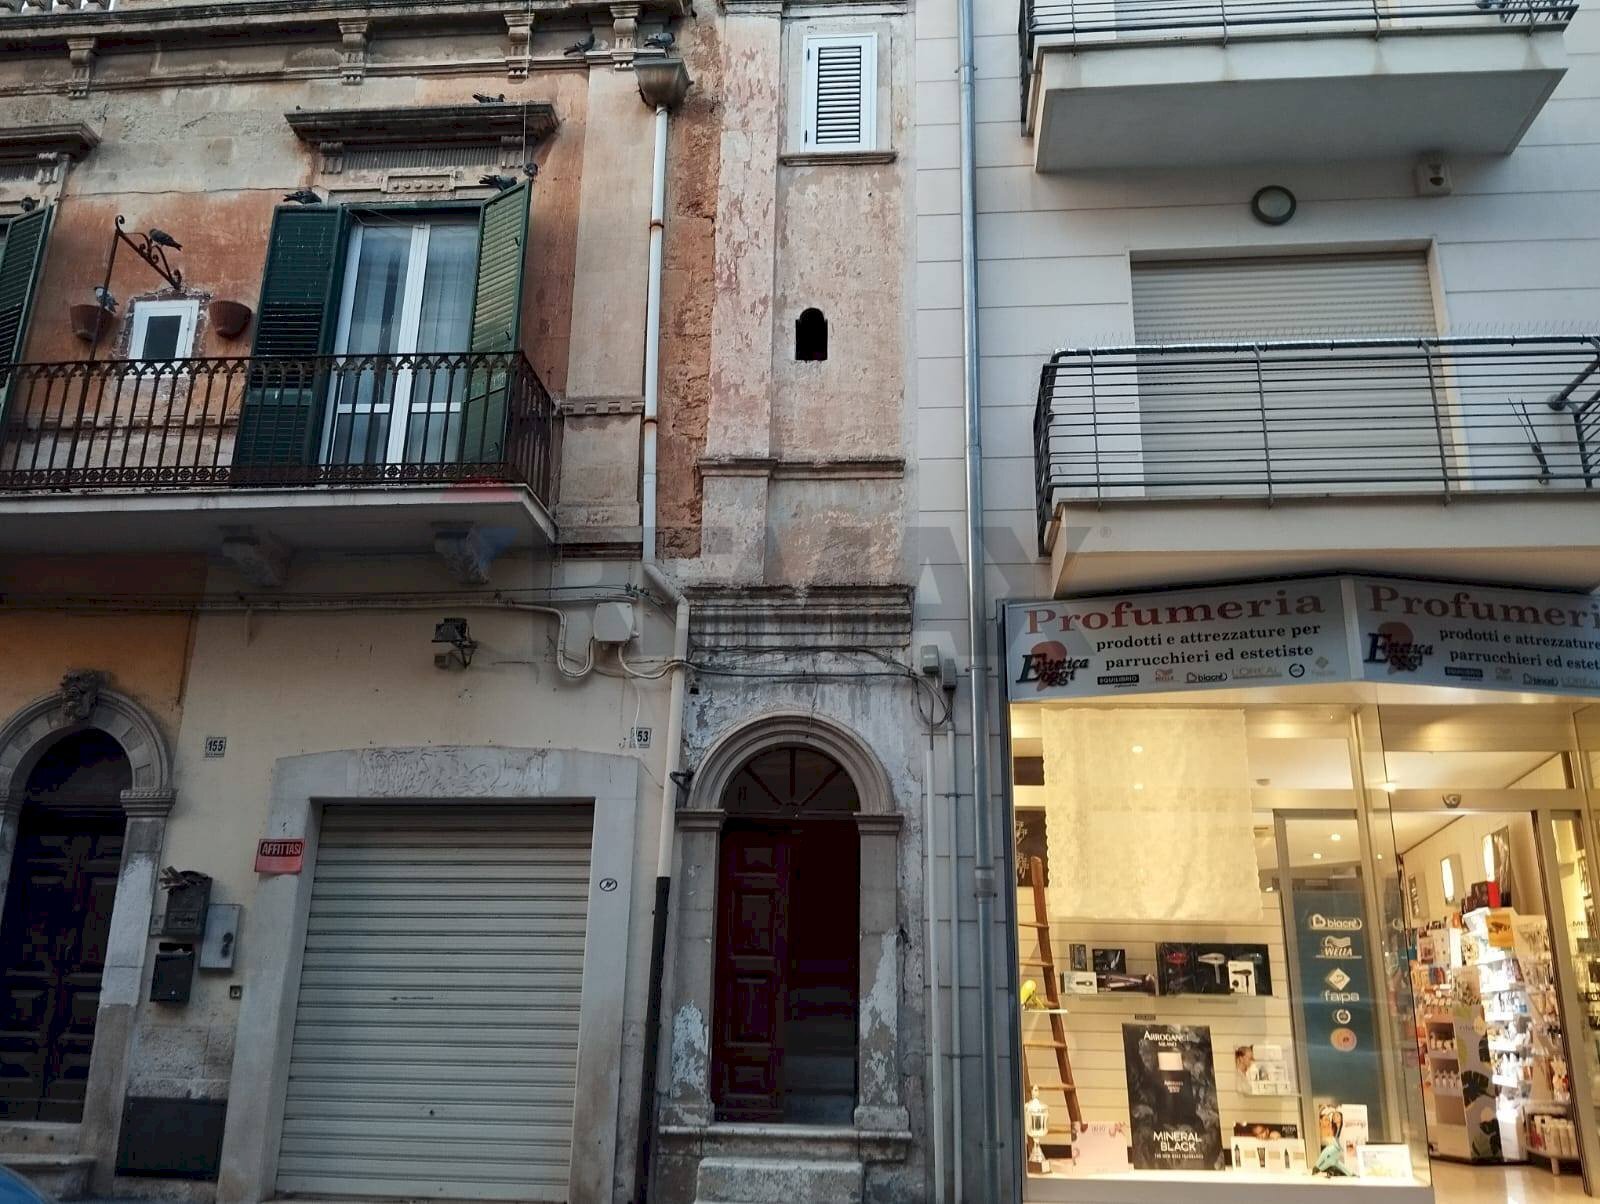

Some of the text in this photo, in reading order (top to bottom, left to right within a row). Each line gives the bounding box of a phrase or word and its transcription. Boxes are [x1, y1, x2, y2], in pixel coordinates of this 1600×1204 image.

[1024, 589, 1326, 635] Profumeria
[1097, 624, 1321, 652] prodotti e attrezzature per
[1440, 628, 1499, 642] prodotti
[1503, 634, 1512, 643] e
[1106, 644, 1314, 671] parrucchieri ed estetiste
[1450, 650, 1542, 666] parrucchieri
[1546, 655, 1562, 668] ed
[208, 740, 224, 752] 155
[262, 843, 302, 855] AFFITTASI
[1153, 1131, 1202, 1143] MINERAL
[1161, 1141, 1197, 1152] BLACK
